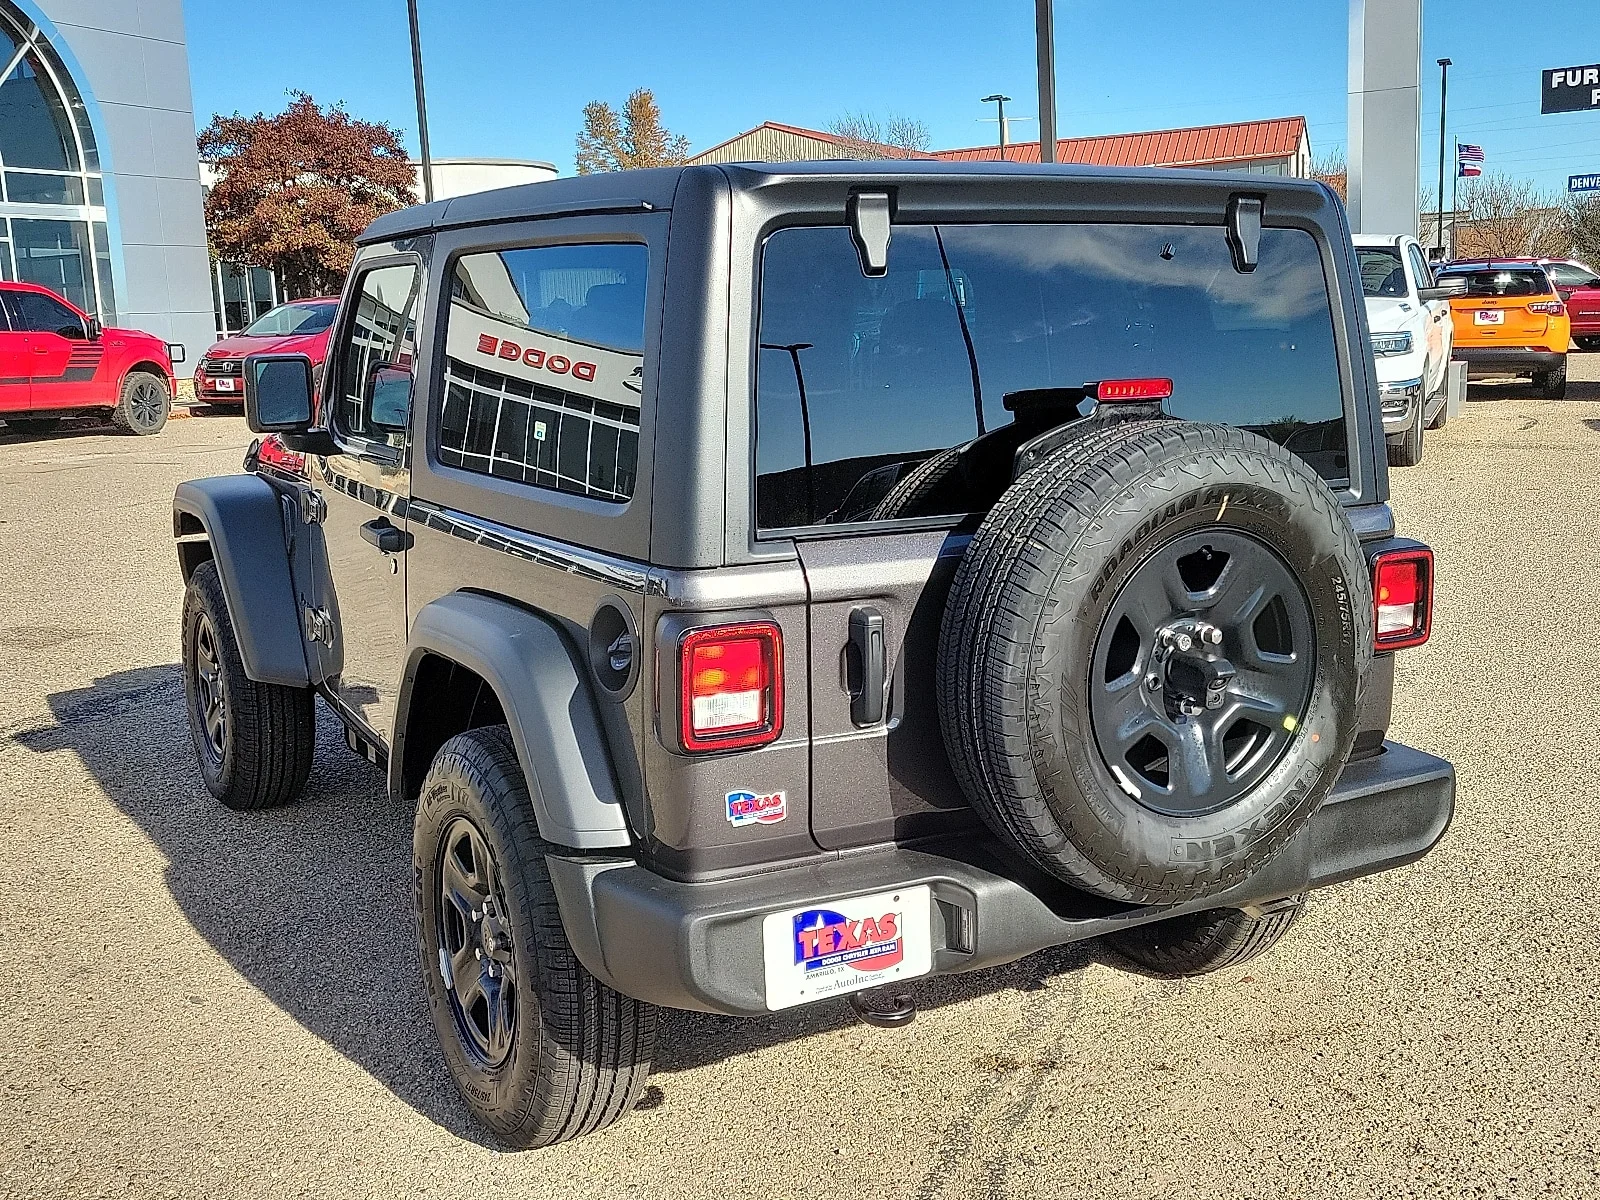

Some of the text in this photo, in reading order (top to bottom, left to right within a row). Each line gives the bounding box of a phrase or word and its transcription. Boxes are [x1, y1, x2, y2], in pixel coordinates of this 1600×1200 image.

[1551, 68, 1599, 89] FUR
[1091, 488, 1200, 602] ROADIAN
[729, 794, 782, 816] TEXAS
[1186, 777, 1307, 861] NEXEN
[798, 912, 898, 959] TEXAS
[821, 955, 842, 966] DODGE
